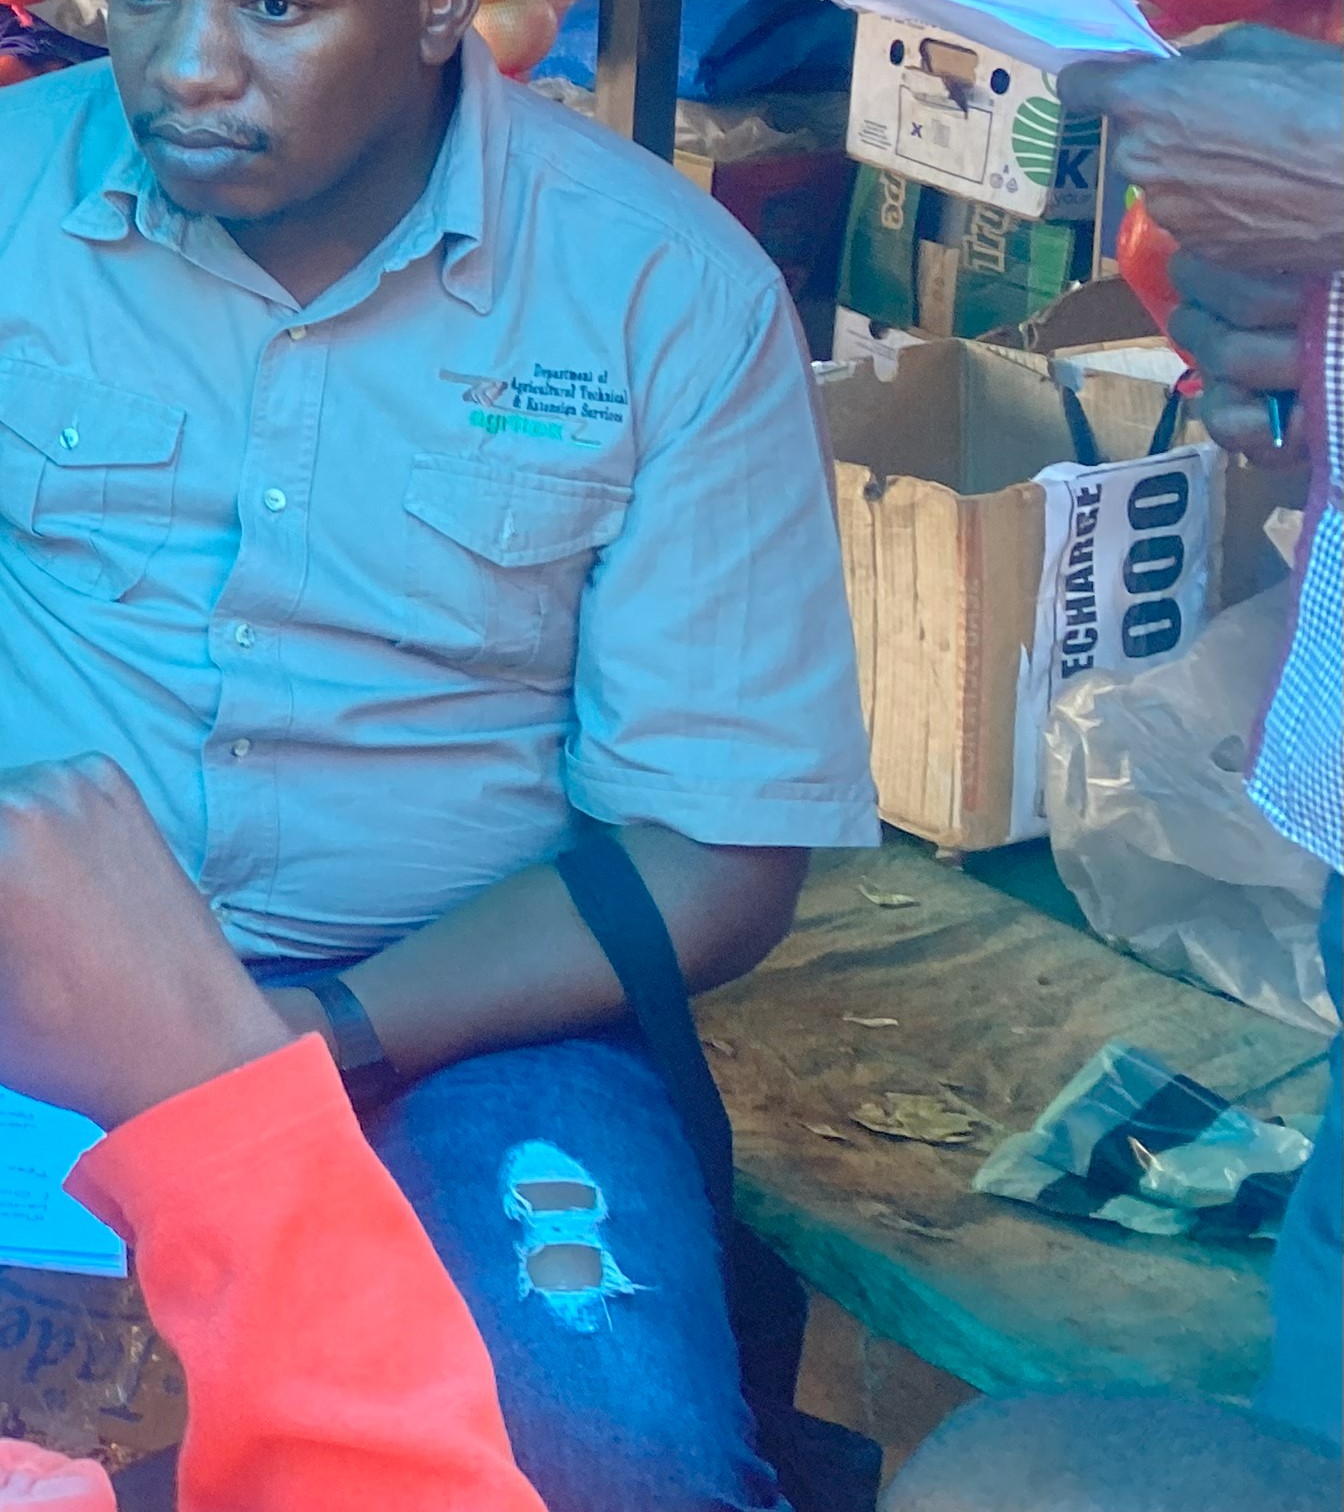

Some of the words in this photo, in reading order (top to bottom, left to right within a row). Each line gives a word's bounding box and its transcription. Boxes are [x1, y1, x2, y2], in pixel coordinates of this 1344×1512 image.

[534, 363, 593, 383] Department
[511, 377, 576, 399] Agricultural
[580, 385, 628, 405] Technical
[526, 397, 576, 416] Extension
[581, 404, 623, 422] Services
[1121, 472, 1188, 658] 000
